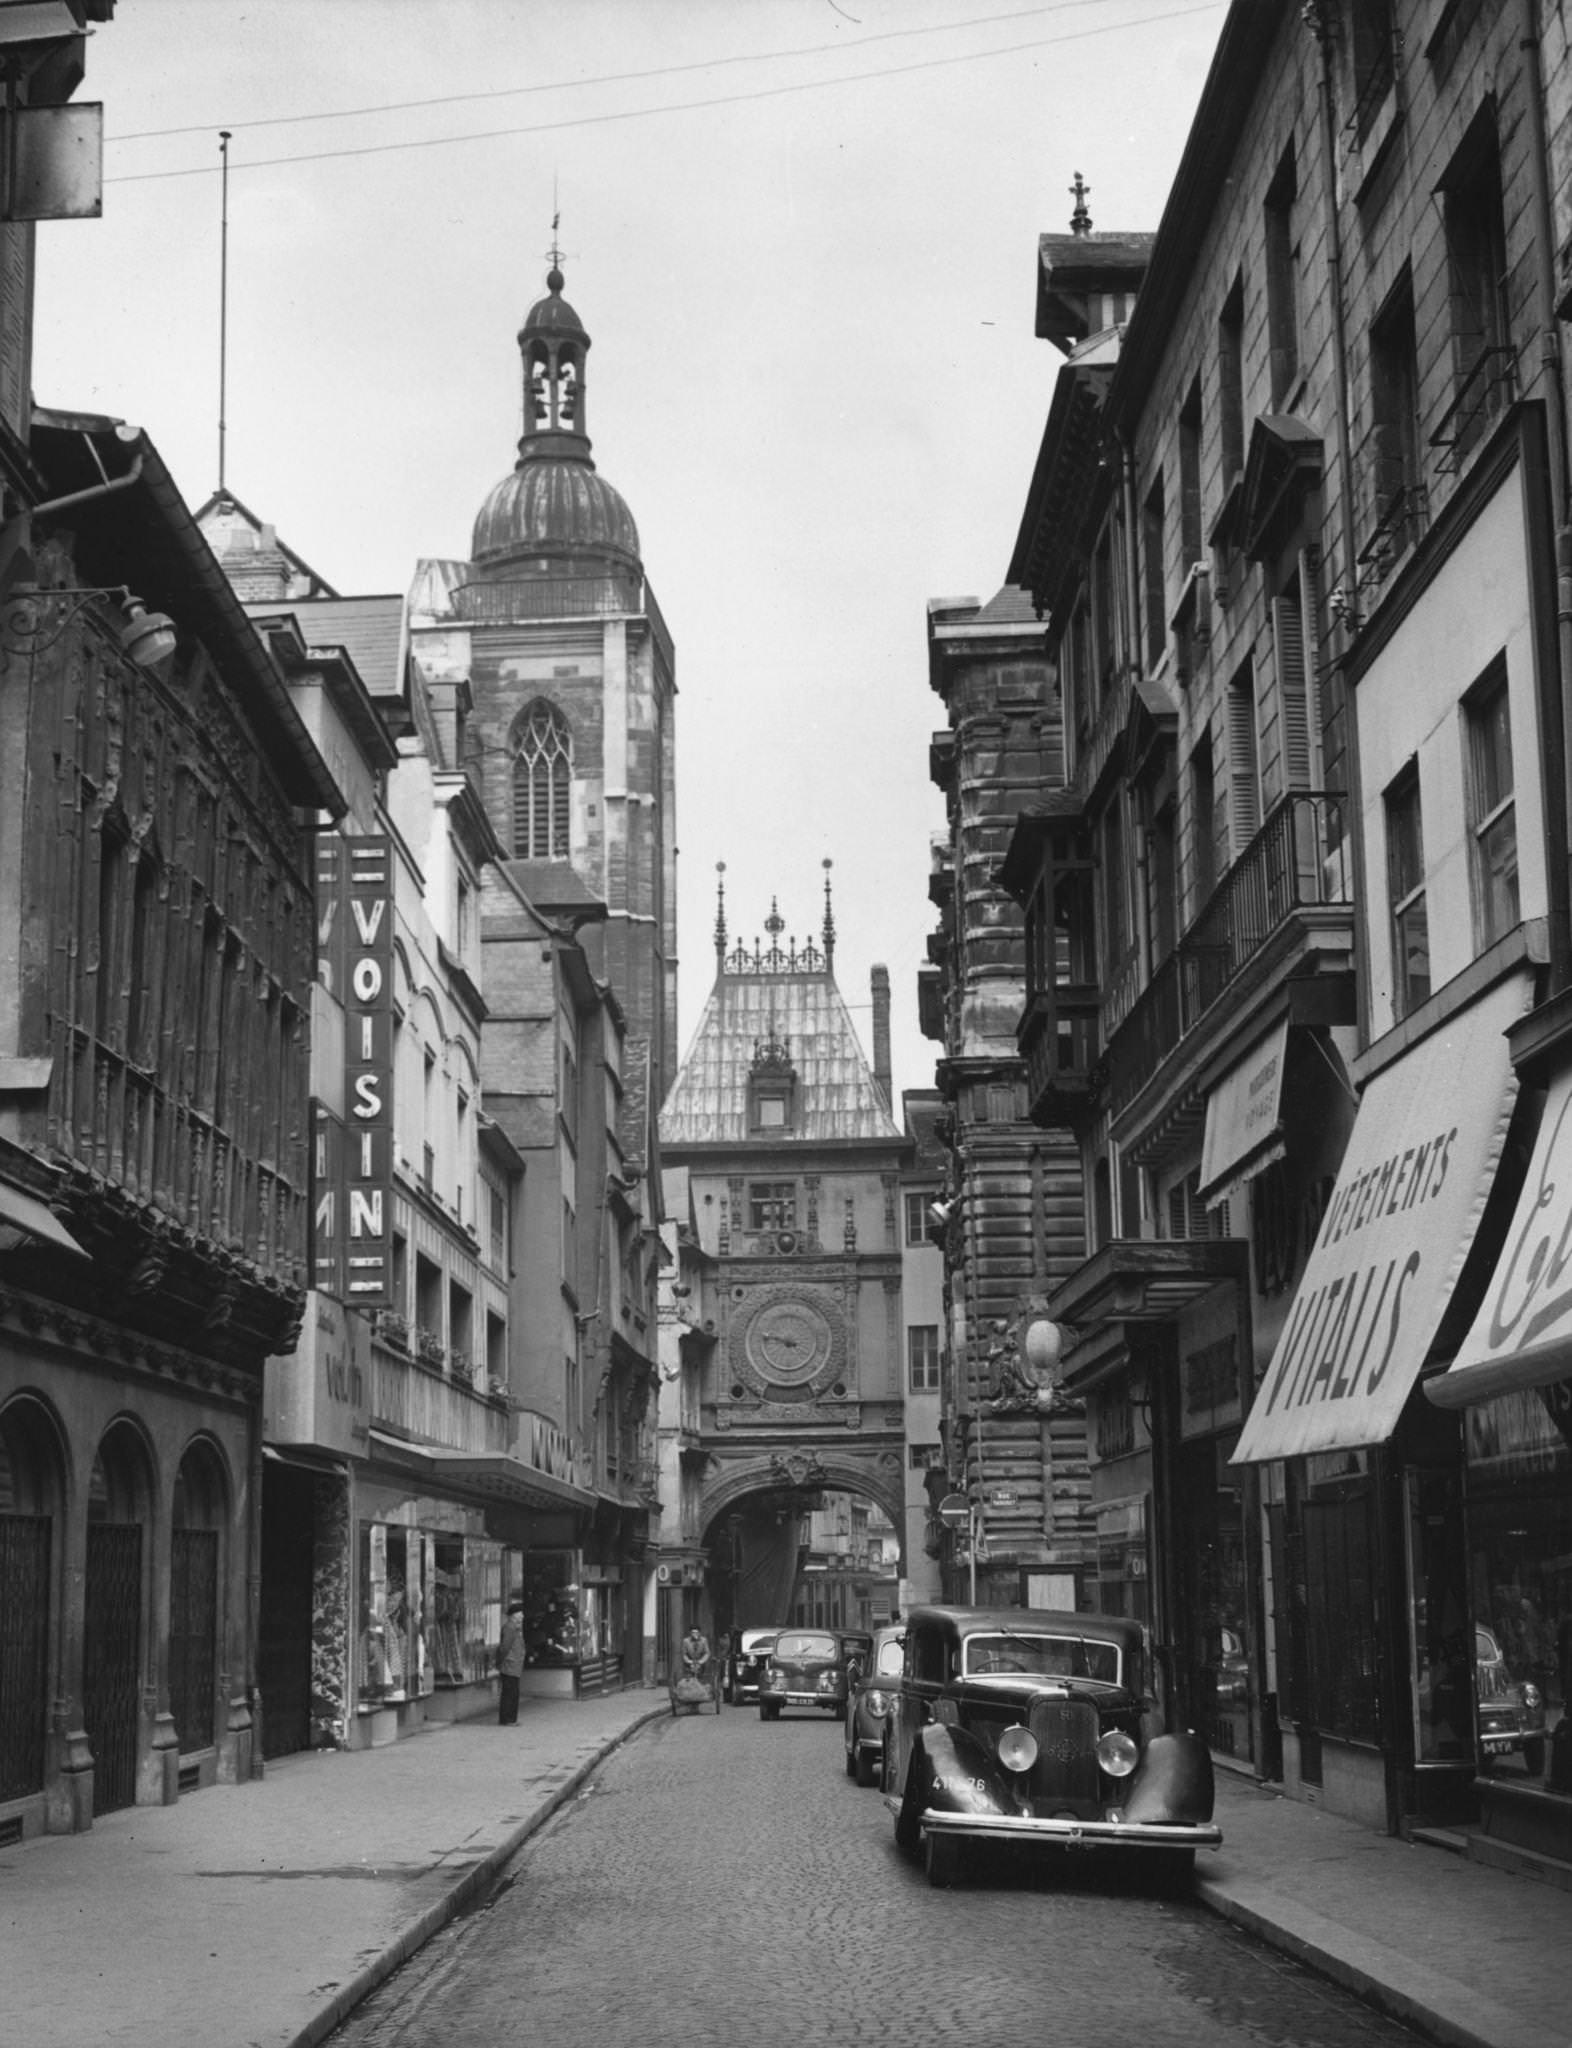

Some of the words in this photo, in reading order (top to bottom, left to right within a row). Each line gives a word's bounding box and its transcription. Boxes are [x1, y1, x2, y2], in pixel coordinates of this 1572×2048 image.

[350, 900, 385, 1237] VOISIN
[1322, 1127, 1458, 1249] VÊTEMENTS
[1266, 1250, 1420, 1417] VITALIS
